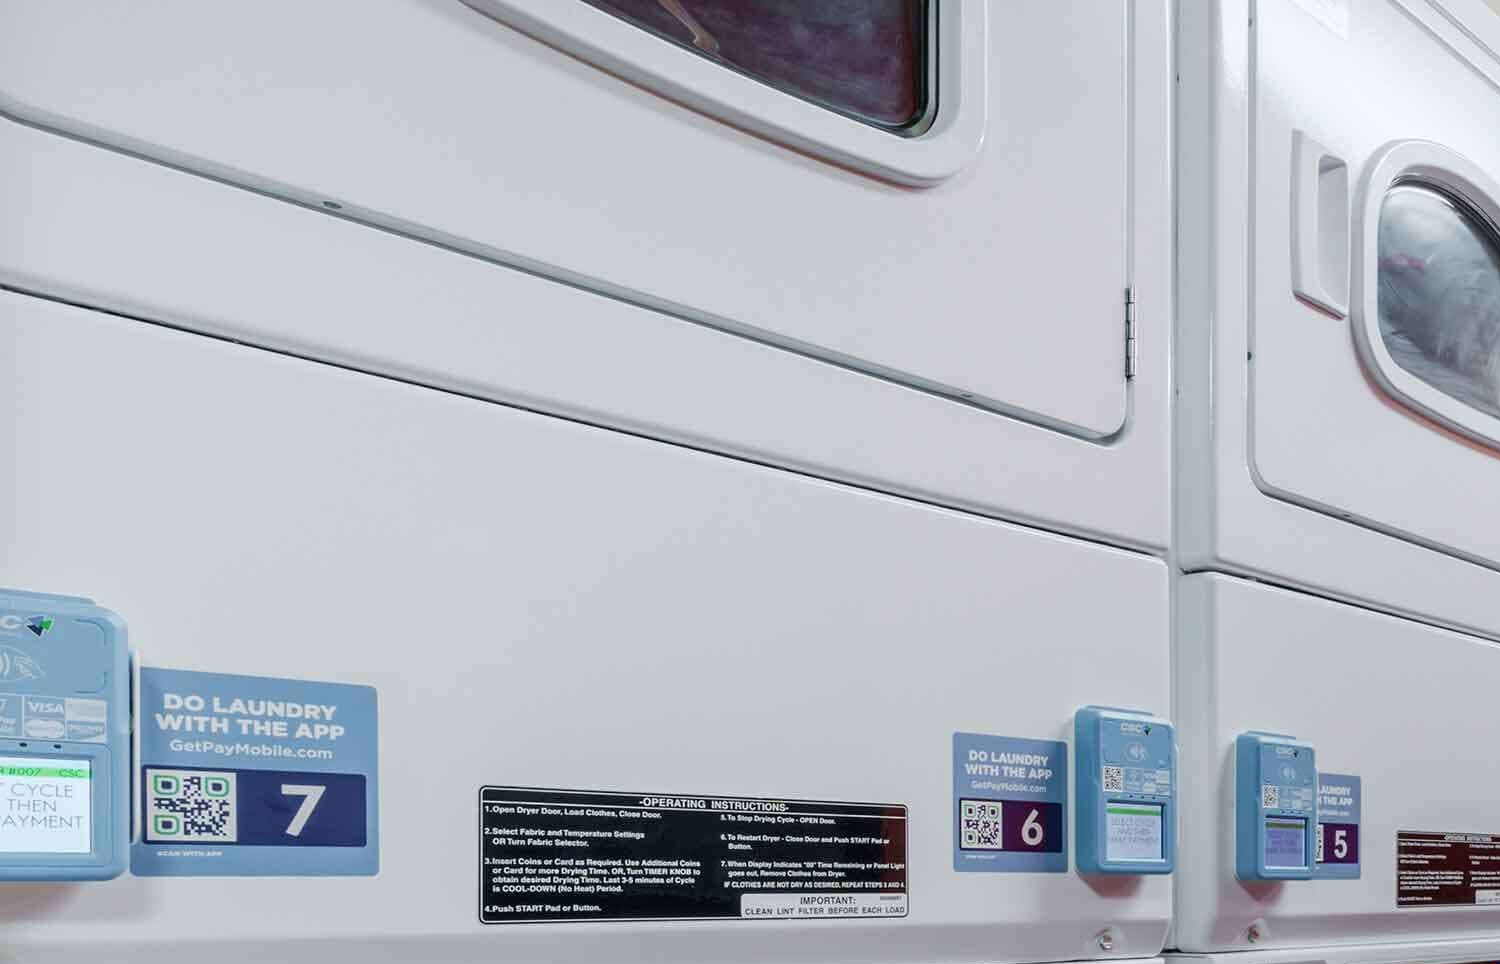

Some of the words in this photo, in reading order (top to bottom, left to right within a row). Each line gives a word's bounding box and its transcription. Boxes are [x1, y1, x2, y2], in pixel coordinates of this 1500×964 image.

[27, 701, 64, 713] VISA
[163, 693, 206, 712] DO
[212, 697, 337, 721] LAUNDRY
[155, 713, 229, 734] WITH
[236, 718, 289, 737] THE
[294, 724, 345, 740] APP
[169, 739, 333, 760] GetPayMobile.com
[968, 750, 988, 762] DO
[991, 752, 1048, 768] LAUNDRY
[59, 769, 84, 778] CSC
[965, 763, 999, 777] WITH
[1002, 766, 1027, 779] THE
[1029, 768, 1052, 781] APP
[10, 783, 73, 798] CYCLE
[971, 781, 1047, 793] GetPayMobile.com
[7, 799, 57, 813] THEN
[281, 784, 326, 837] 7
[0, 815, 84, 829] AYMENT
[1021, 809, 1044, 846] 6
[1334, 830, 1348, 859] 5
[800, 896, 856, 904] IMPORTANT:
[744, 908, 772, 916] CLEAN
